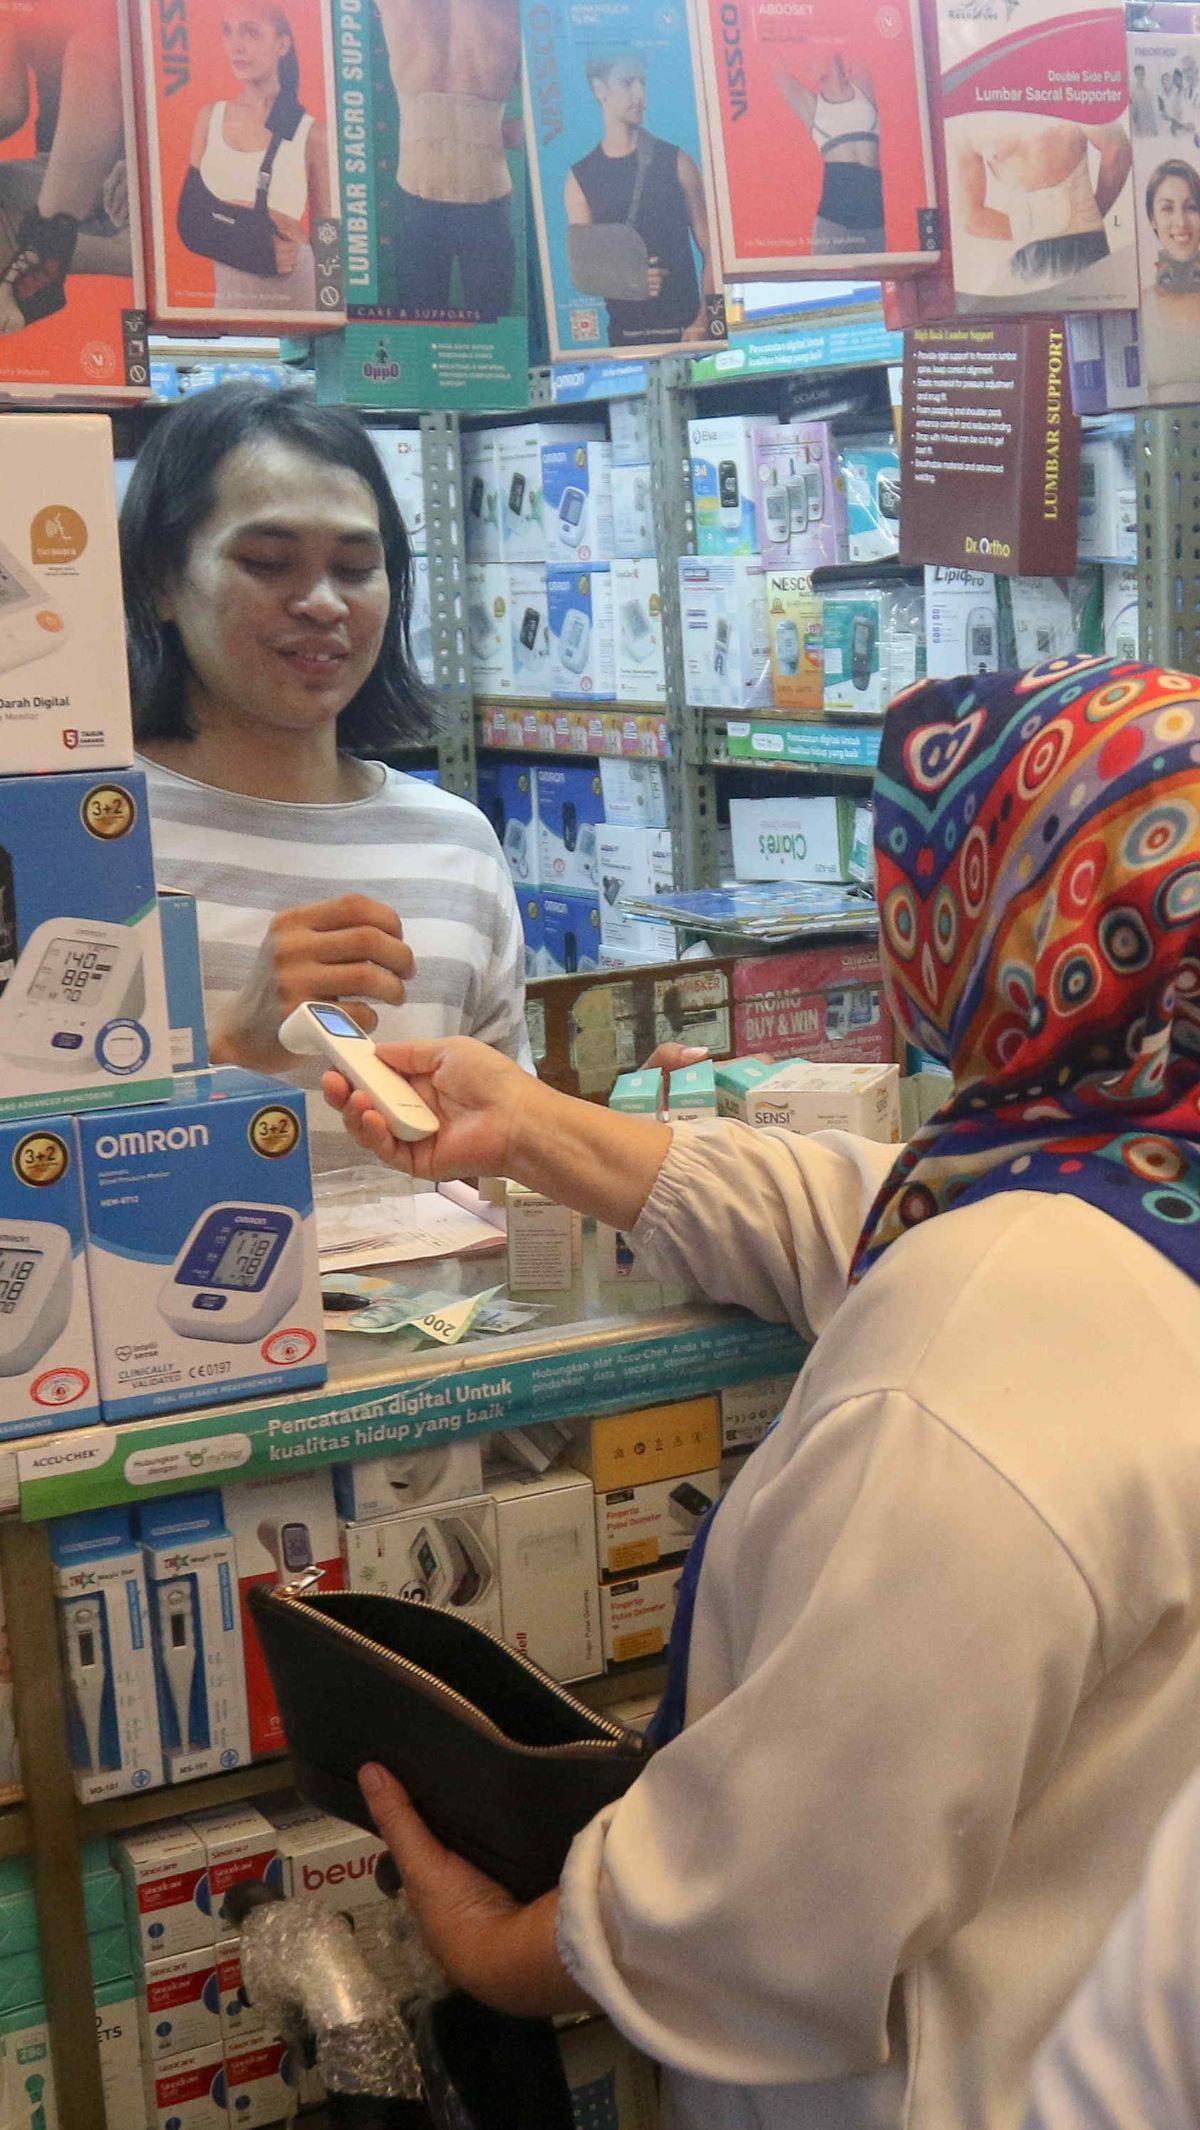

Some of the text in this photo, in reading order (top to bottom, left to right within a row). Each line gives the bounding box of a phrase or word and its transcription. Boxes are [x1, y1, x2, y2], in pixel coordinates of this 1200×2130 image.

[721, 4, 747, 122] VISSCO
[1048, 70, 1121, 83] Double Side Pull
[976, 87, 1121, 104] Lumbar Sacral Supporter
[344, 90, 366, 174] SACRO
[346, 182, 370, 286] LUMBAR
[358, 308, 393, 317] CARE
[415, 309, 481, 320] SUPPORTS
[1043, 328, 1064, 521] SUPPORT LUMBAR
[965, 536, 1011, 557] Dr.Ortho
[33, 697, 70, 710] Digital
[92, 798, 123, 816] 3+2
[64, 951, 98, 971] 140
[61, 969, 90, 988] 88
[745, 987, 802, 1016] PROMO
[745, 1008, 819, 1042] BUY & WIN
[258, 1119, 290, 1136] 3+2
[755, 1112, 791, 1125] SENSI
[24, 1145, 58, 1165] 3+2
[420, 1311, 456, 1339] 200
[118, 1363, 174, 1380] CLINICALLY
[532, 1361, 590, 1379] Hubungkan
[132, 1374, 182, 1389] VALIDATED
[267, 1378, 513, 1438] Pencatatan digital Untuk
[269, 1402, 506, 1462] kualitas hidup yang baik
[31, 1450, 97, 1468] ACCU-CHEK
[133, 1453, 179, 1468] Hubungkan
[302, 1852, 379, 1891] beur
